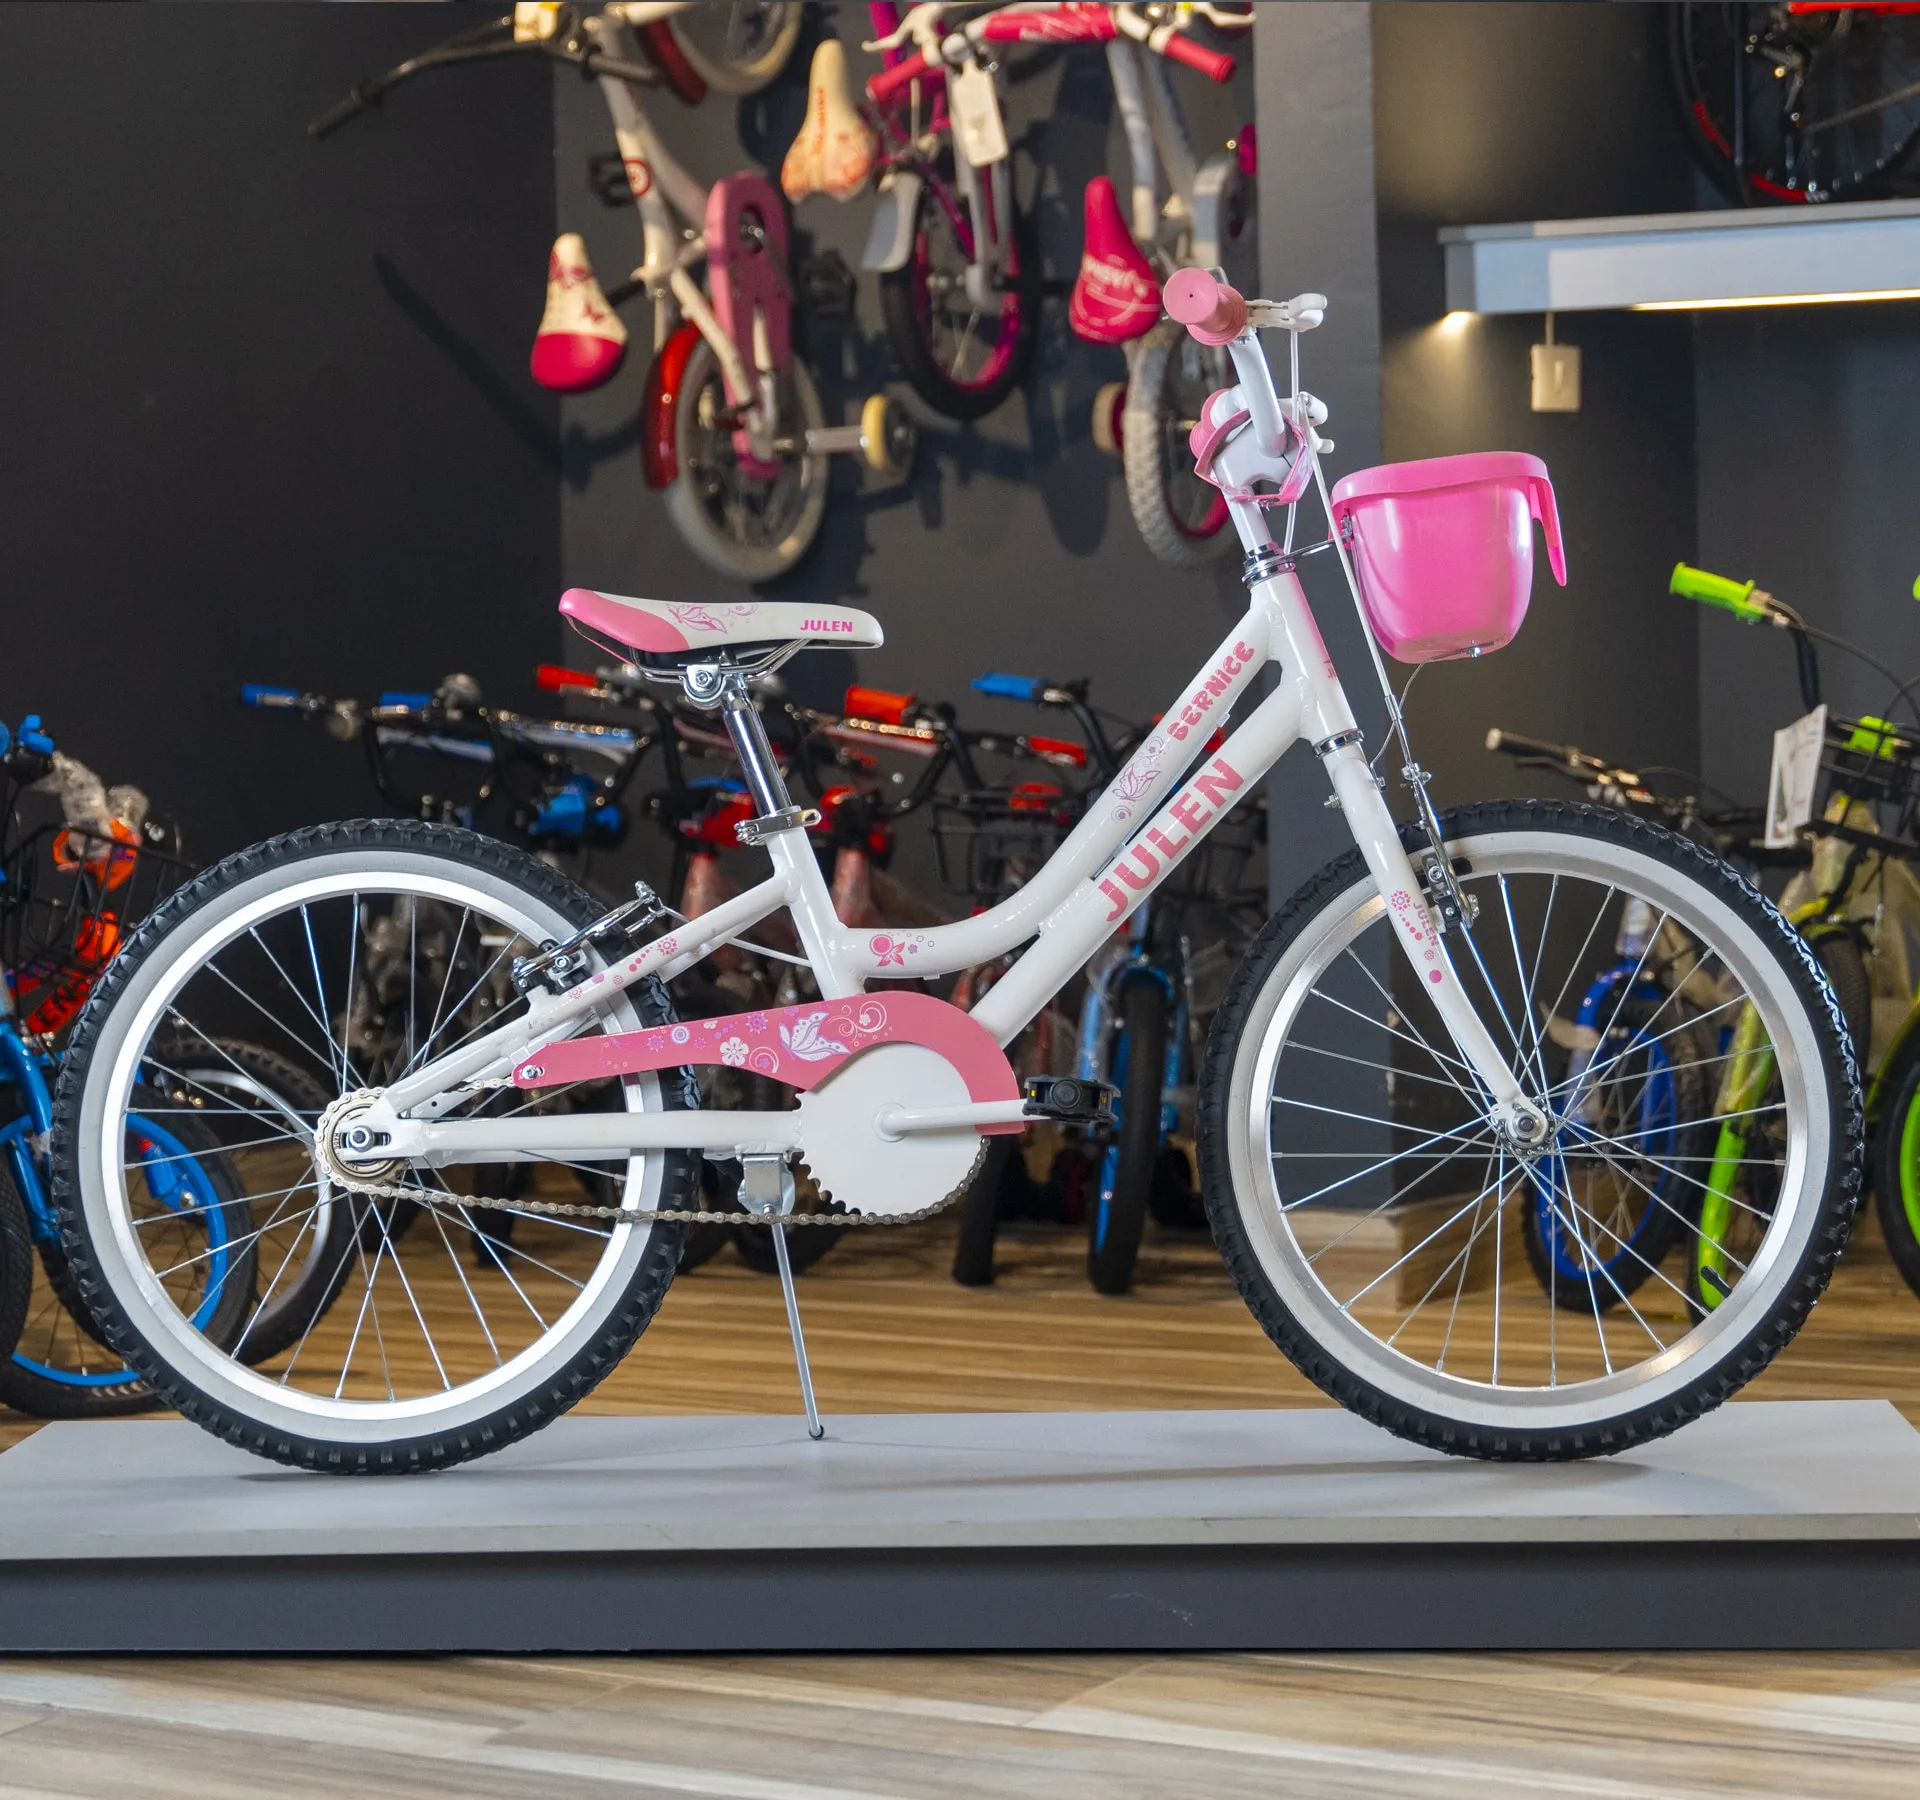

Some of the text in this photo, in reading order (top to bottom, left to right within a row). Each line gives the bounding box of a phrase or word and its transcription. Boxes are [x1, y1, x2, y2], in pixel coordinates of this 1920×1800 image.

[800, 619, 853, 632] JULEN
[1167, 641, 1255, 741] BERNICE
[1098, 757, 1244, 922] JULEN
[1413, 903, 1440, 946] JULEN
